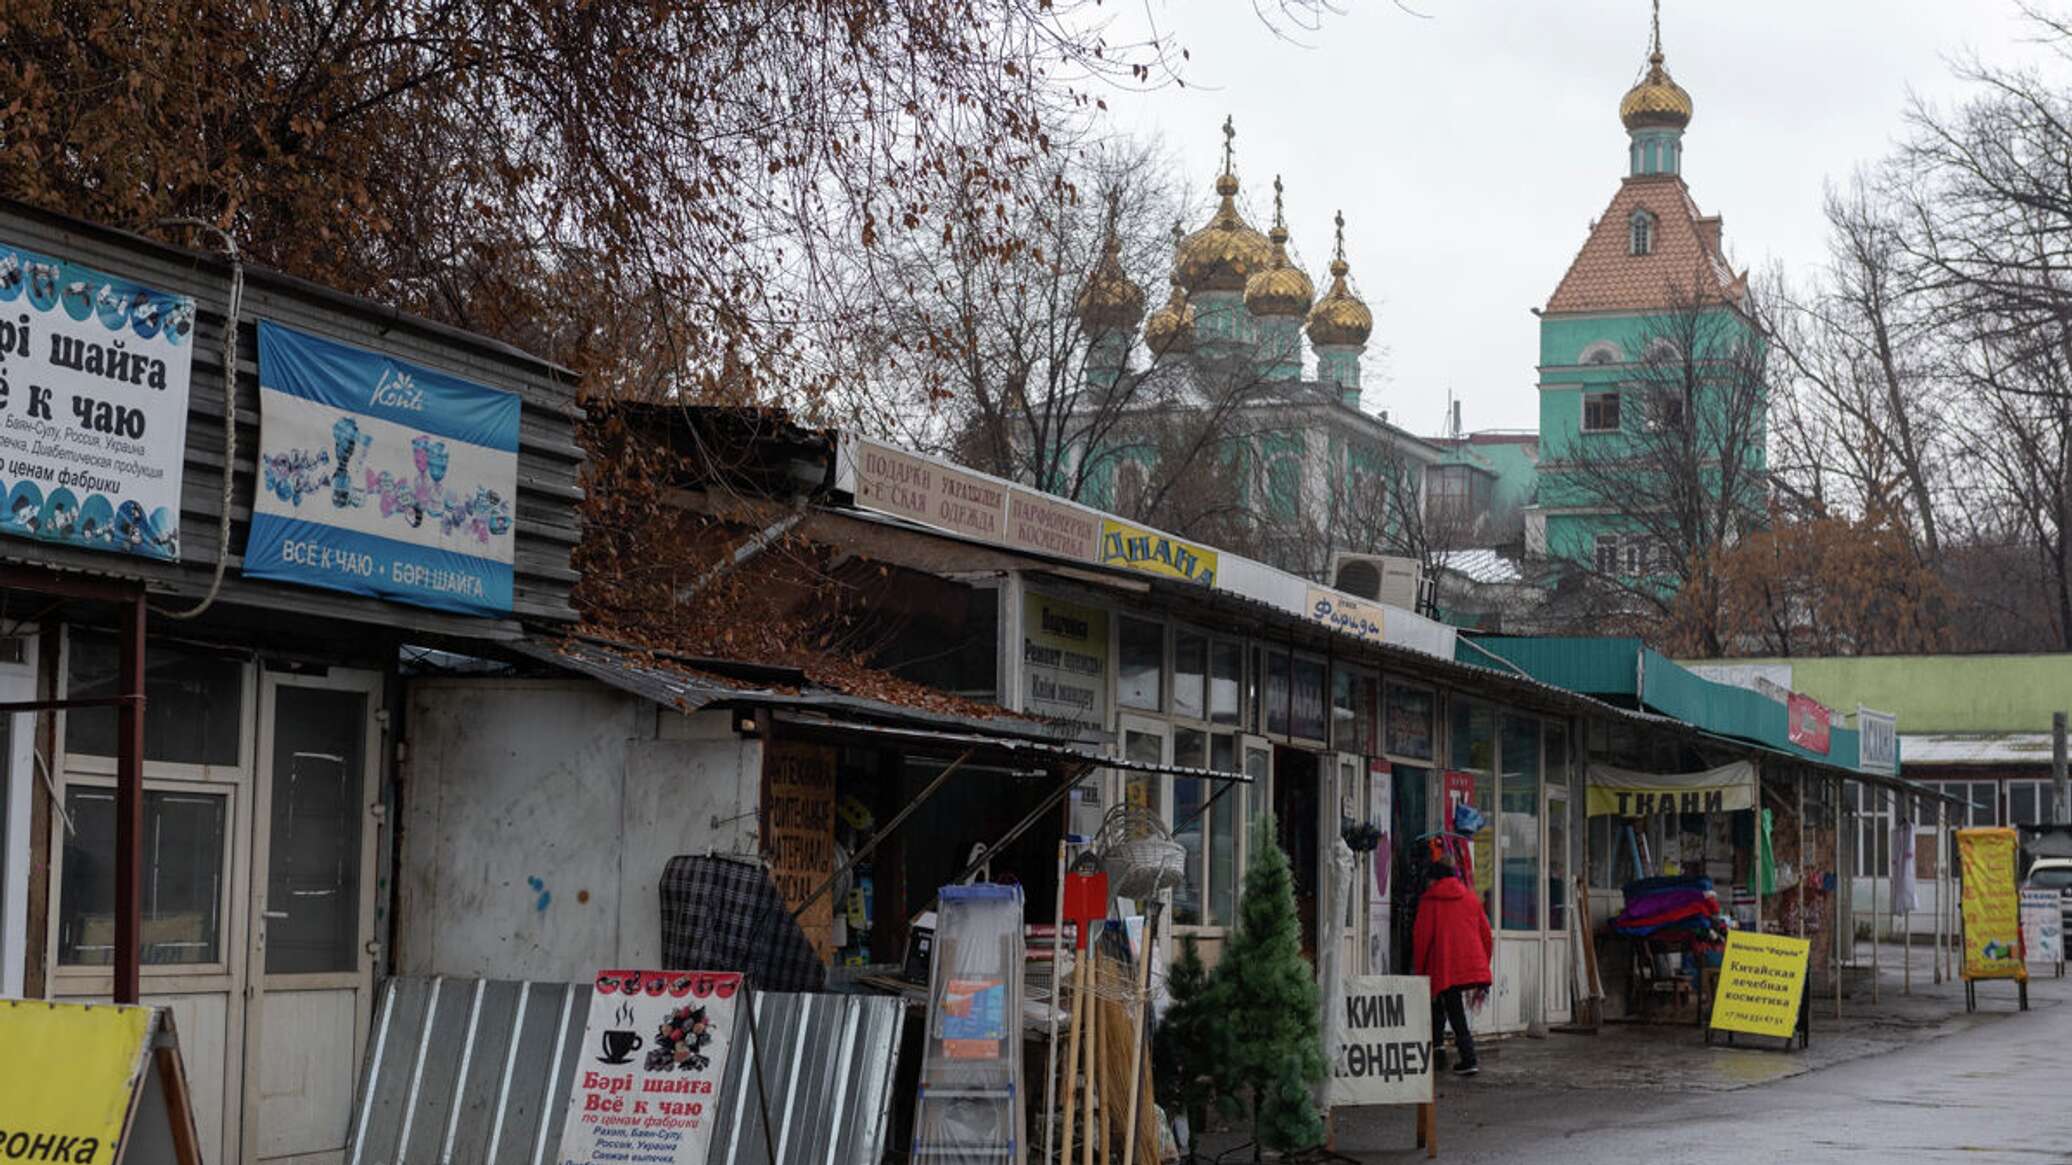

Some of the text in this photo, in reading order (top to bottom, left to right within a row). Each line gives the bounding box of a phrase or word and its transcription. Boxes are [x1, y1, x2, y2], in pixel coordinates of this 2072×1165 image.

[49, 333, 167, 391] шайға
[72, 395, 146, 440] чаю
[8, 458, 54, 481] ценам
[58, 466, 121, 494] фабрики
[282, 540, 318, 566] ВСЁ
[321, 546, 331, 569] К
[335, 549, 373, 577] ЧАЮ
[1104, 532, 1213, 591] ДИАНА
[1615, 789, 1722, 816] ТКАНИ
[1731, 960, 1795, 979] Китайская
[1733, 977, 1788, 992] лечебная
[1725, 991, 1790, 1008] косметика
[582, 1071, 712, 1095] Бәрі шайға
[584, 1094, 624, 1113] Всё
[659, 1101, 703, 1116] чаю
[581, 1114, 700, 1130] по ценам фабрики
